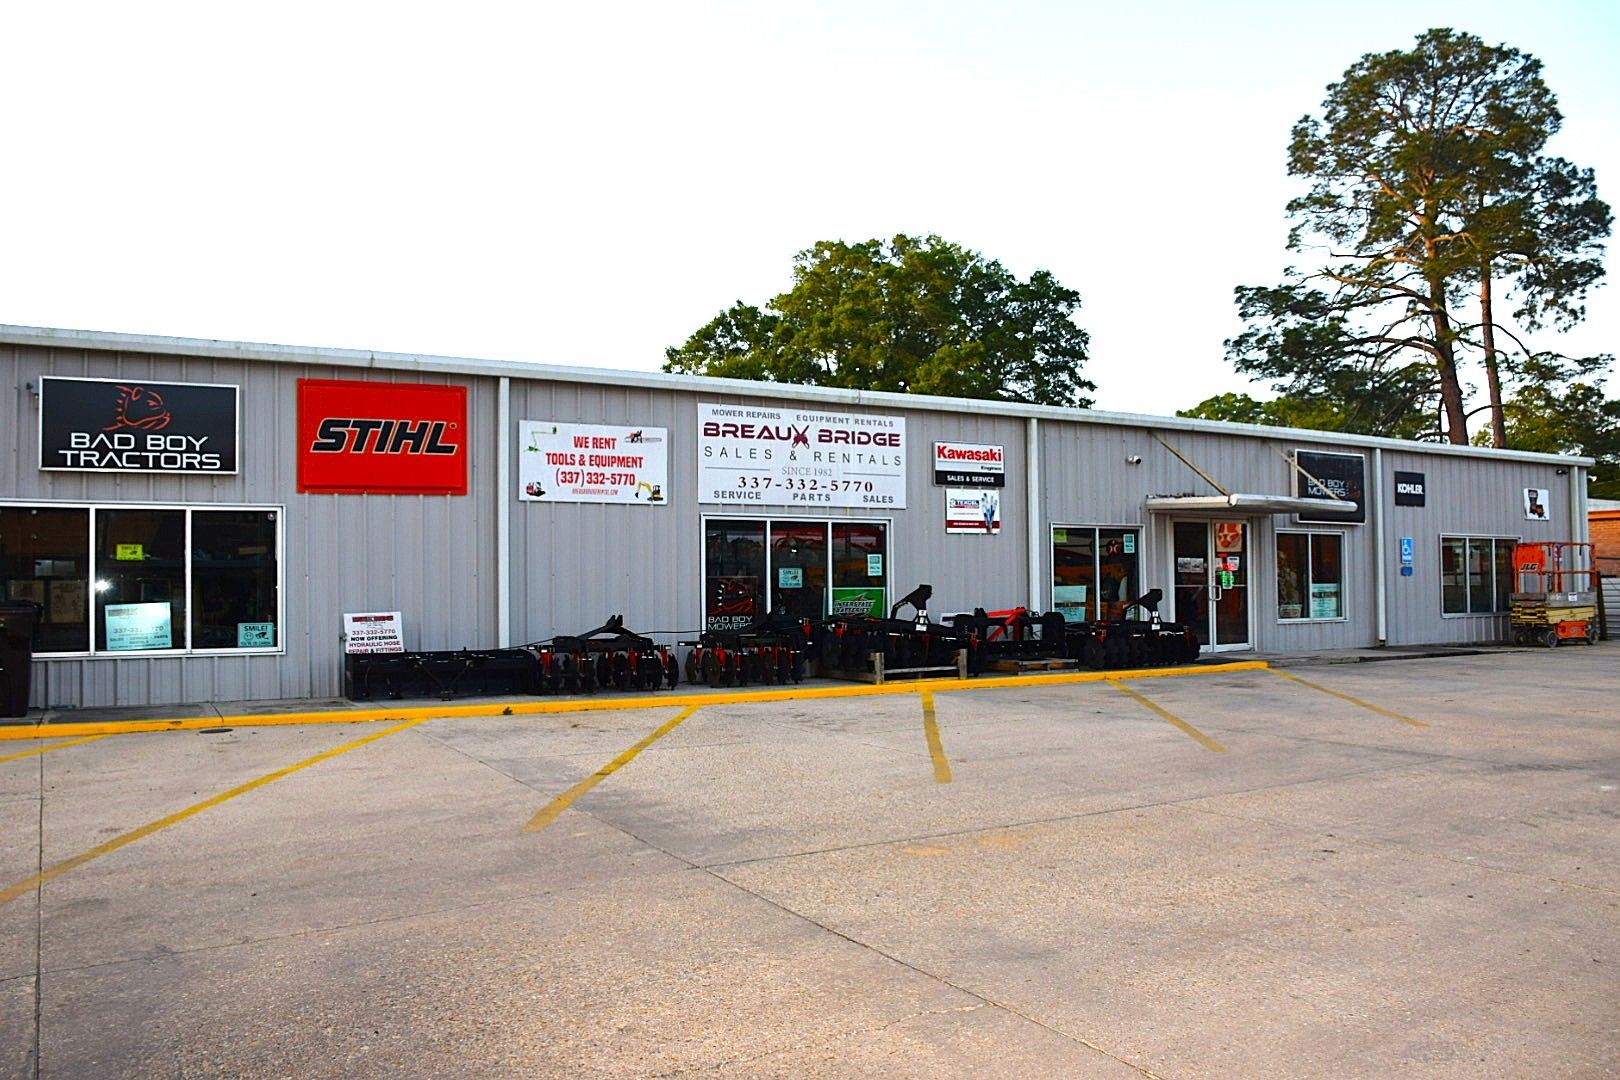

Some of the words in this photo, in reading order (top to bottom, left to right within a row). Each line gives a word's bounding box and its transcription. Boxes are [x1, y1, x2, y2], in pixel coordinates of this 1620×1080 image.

[711, 408, 744, 418] MOWER
[746, 411, 781, 420] REPAIRS
[796, 414, 850, 425] EQUIPMENT
[854, 418, 894, 428] RENTALS
[70, 432, 135, 450] BAD
[146, 434, 209, 452] BOY
[310, 417, 458, 456] STIHL
[573, 435, 590, 449] WE
[592, 436, 617, 450] RENT
[703, 422, 810, 449] BREAUX
[817, 428, 901, 447] BRIDGE
[58, 450, 221, 470] TRACTORS
[545, 452, 576, 466] TOOLS
[578, 453, 586, 467] &
[589, 454, 644, 469] EQUIPMENT
[704, 445, 773, 460] SALES
[789, 450, 798, 461] &
[813, 451, 901, 466] RENTALS
[937, 445, 1002, 462] Kawasaki
[781, 466, 812, 476] SINCE
[813, 467, 833, 477] 1982
[946, 474, 965, 482] SALES
[738, 476, 873, 493] 337-332-5770
[1308, 477, 1326, 487] BD
[1327, 479, 1345, 488] BOY
[713, 490, 762, 500] SERVICE
[792, 493, 831, 502] PARTS
[862, 494, 894, 504] SALES
[1520, 563, 1537, 571] JLG
[732, 615, 753, 623] BOY
[352, 628, 396, 636] 337-332-5770
